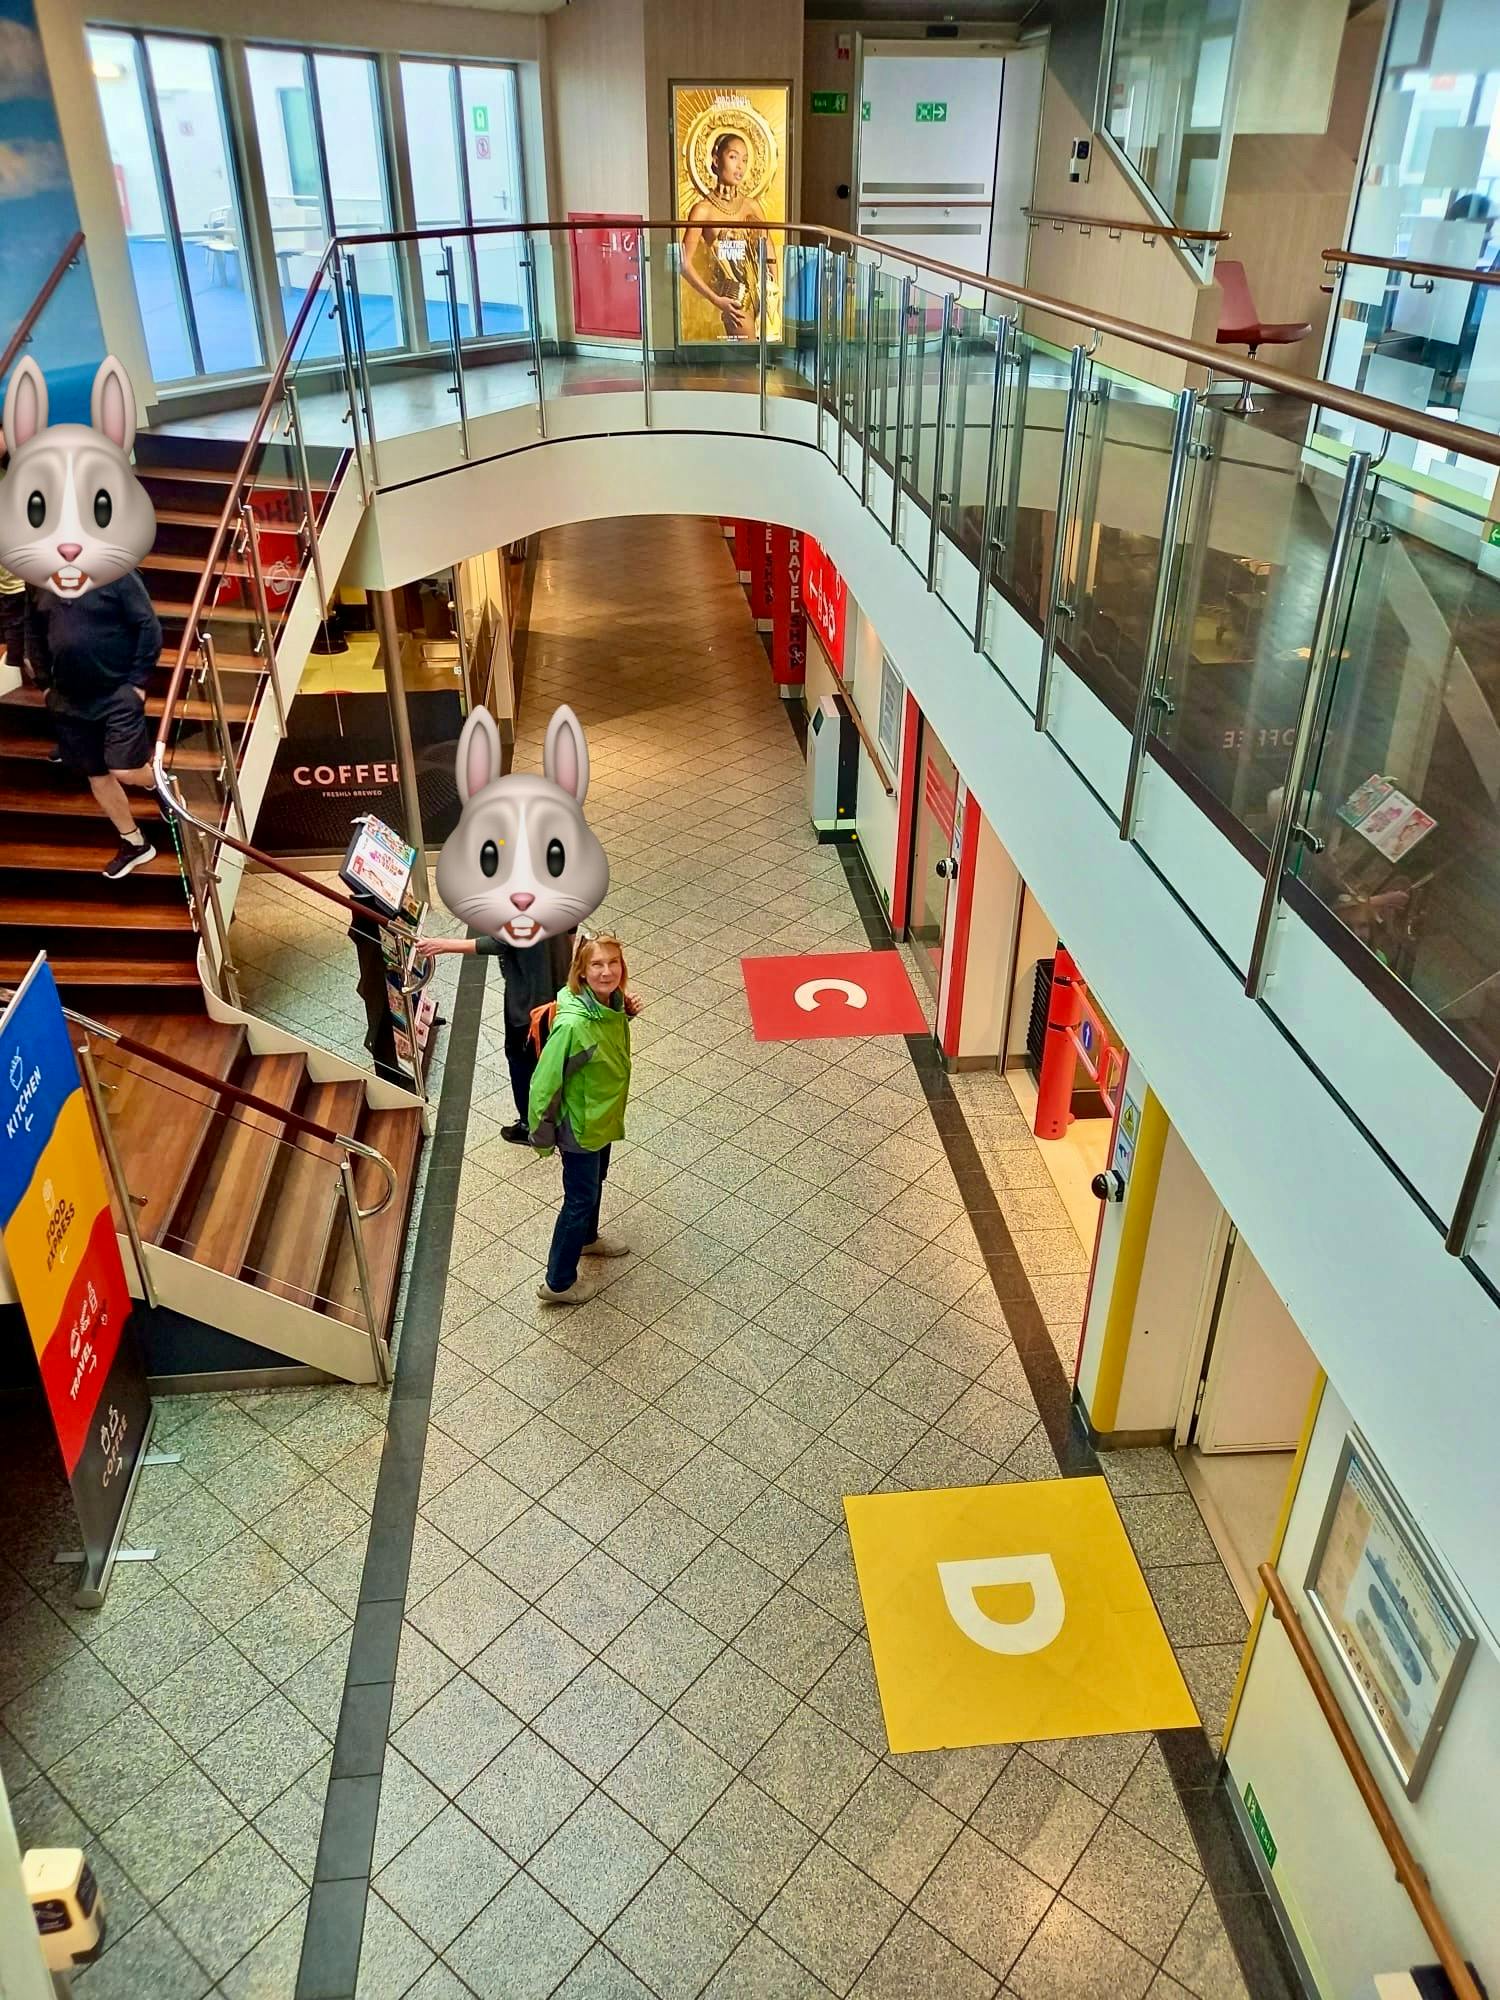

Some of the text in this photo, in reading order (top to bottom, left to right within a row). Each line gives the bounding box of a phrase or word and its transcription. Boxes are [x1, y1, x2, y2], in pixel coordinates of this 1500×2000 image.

[718, 248, 746, 260] DIVINE
[794, 978, 868, 1012] C
[6, 1065, 42, 1139] KITCHEN
[46, 1199, 66, 1246] FOOD
[47, 1202, 75, 1272] EXPRESS
[70, 1342, 93, 1400] TRAVEL
[103, 1414, 128, 1488] COFFEE
[936, 1553, 1066, 1656] D
